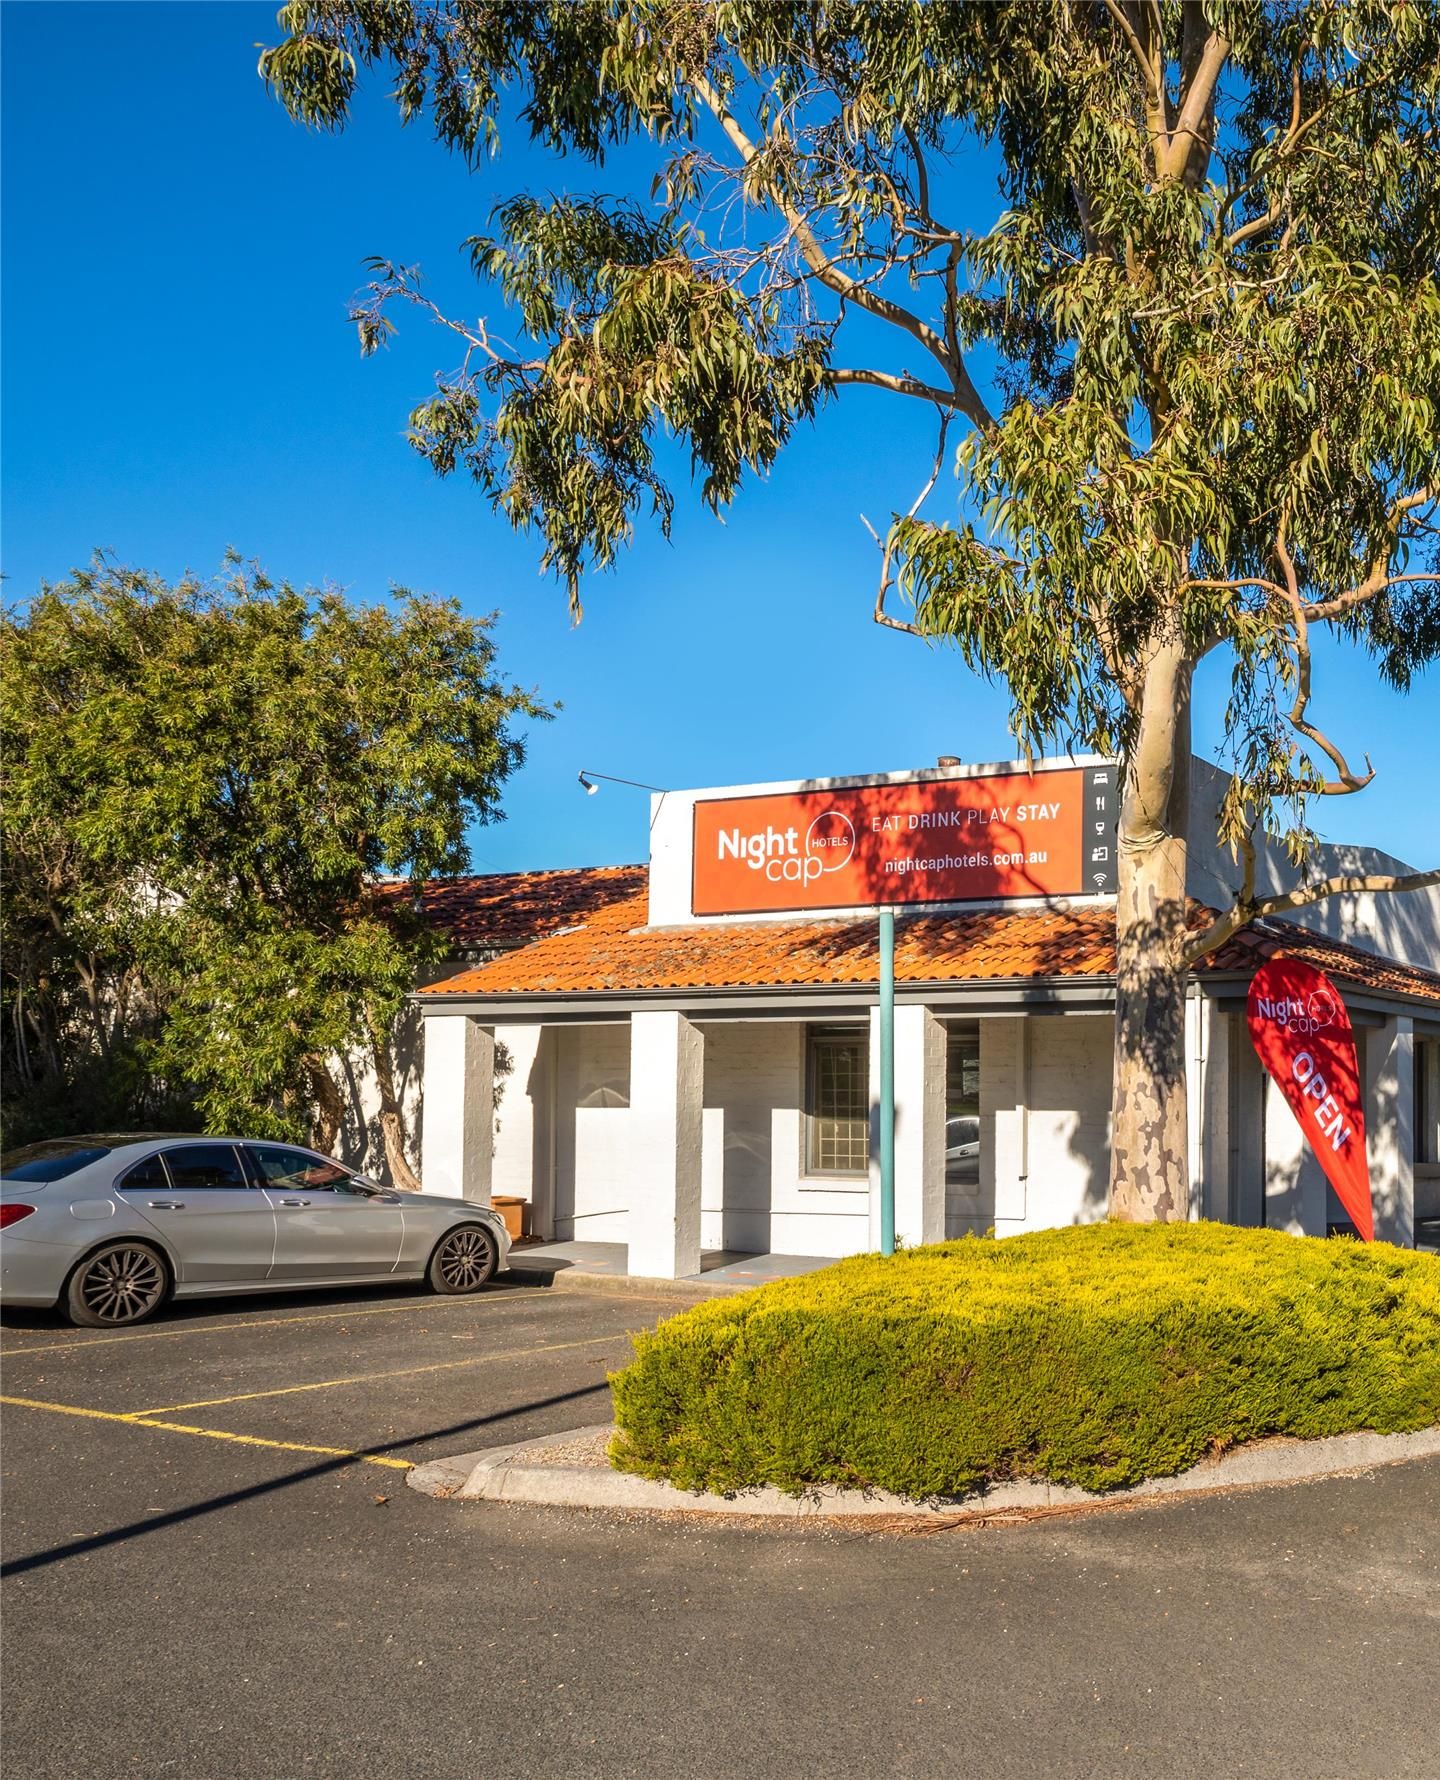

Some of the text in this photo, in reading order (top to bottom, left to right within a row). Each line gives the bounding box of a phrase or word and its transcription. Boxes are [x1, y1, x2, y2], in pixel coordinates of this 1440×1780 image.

[872, 803, 1060, 832] EAT DRINK PLAY STAY
[718, 826, 798, 870] Night
[811, 836, 849, 849] HOTELS
[766, 856, 823, 888] cap
[885, 851, 1048, 875] nightcaphotels.com.au
[1257, 997, 1305, 1025] Night
[1288, 1015, 1320, 1037] cap
[1292, 1051, 1351, 1152] OPEN
